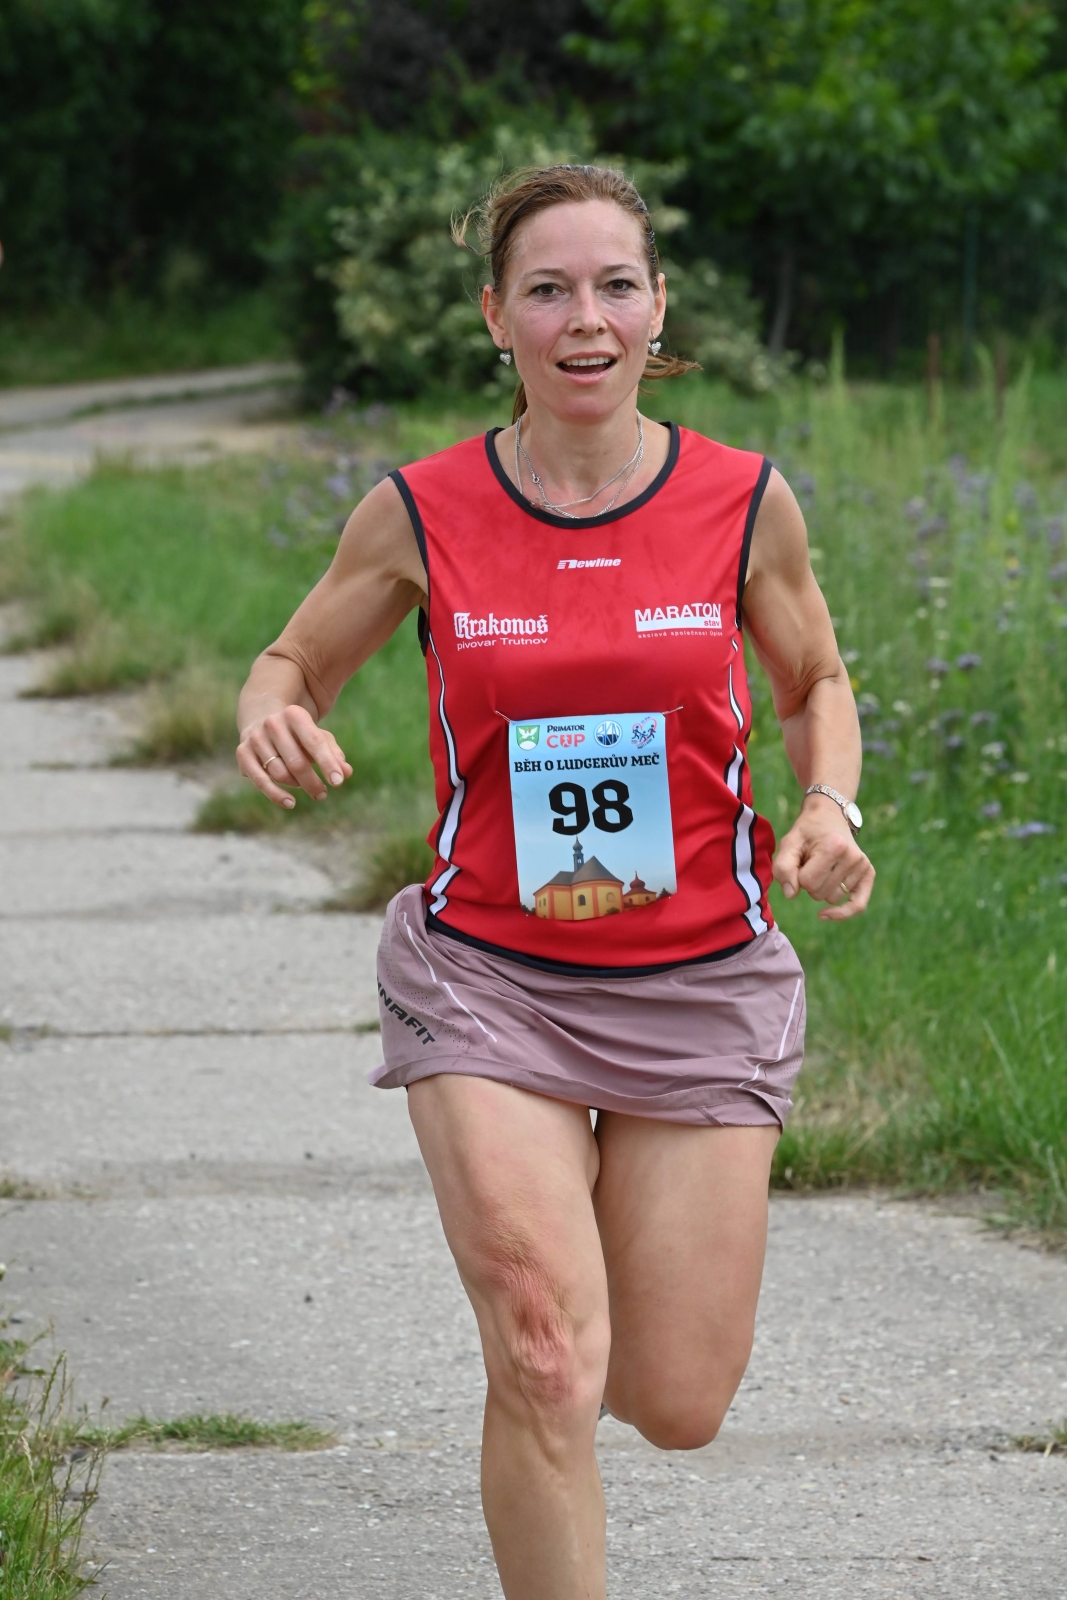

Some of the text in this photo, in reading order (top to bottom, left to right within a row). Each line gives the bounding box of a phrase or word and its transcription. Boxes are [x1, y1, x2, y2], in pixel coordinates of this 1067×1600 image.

[634, 602, 721, 622] MARATON
[453, 611, 549, 639] Krakonoš
[703, 619, 720, 627] stav
[457, 637, 548, 651] pivovar Trutnov
[546, 733, 586, 749] CUP
[514, 751, 660, 773] BĚH O LUDGERŮV MEČ
[549, 779, 634, 836] 98
[377, 976, 436, 1045] NAFIT
